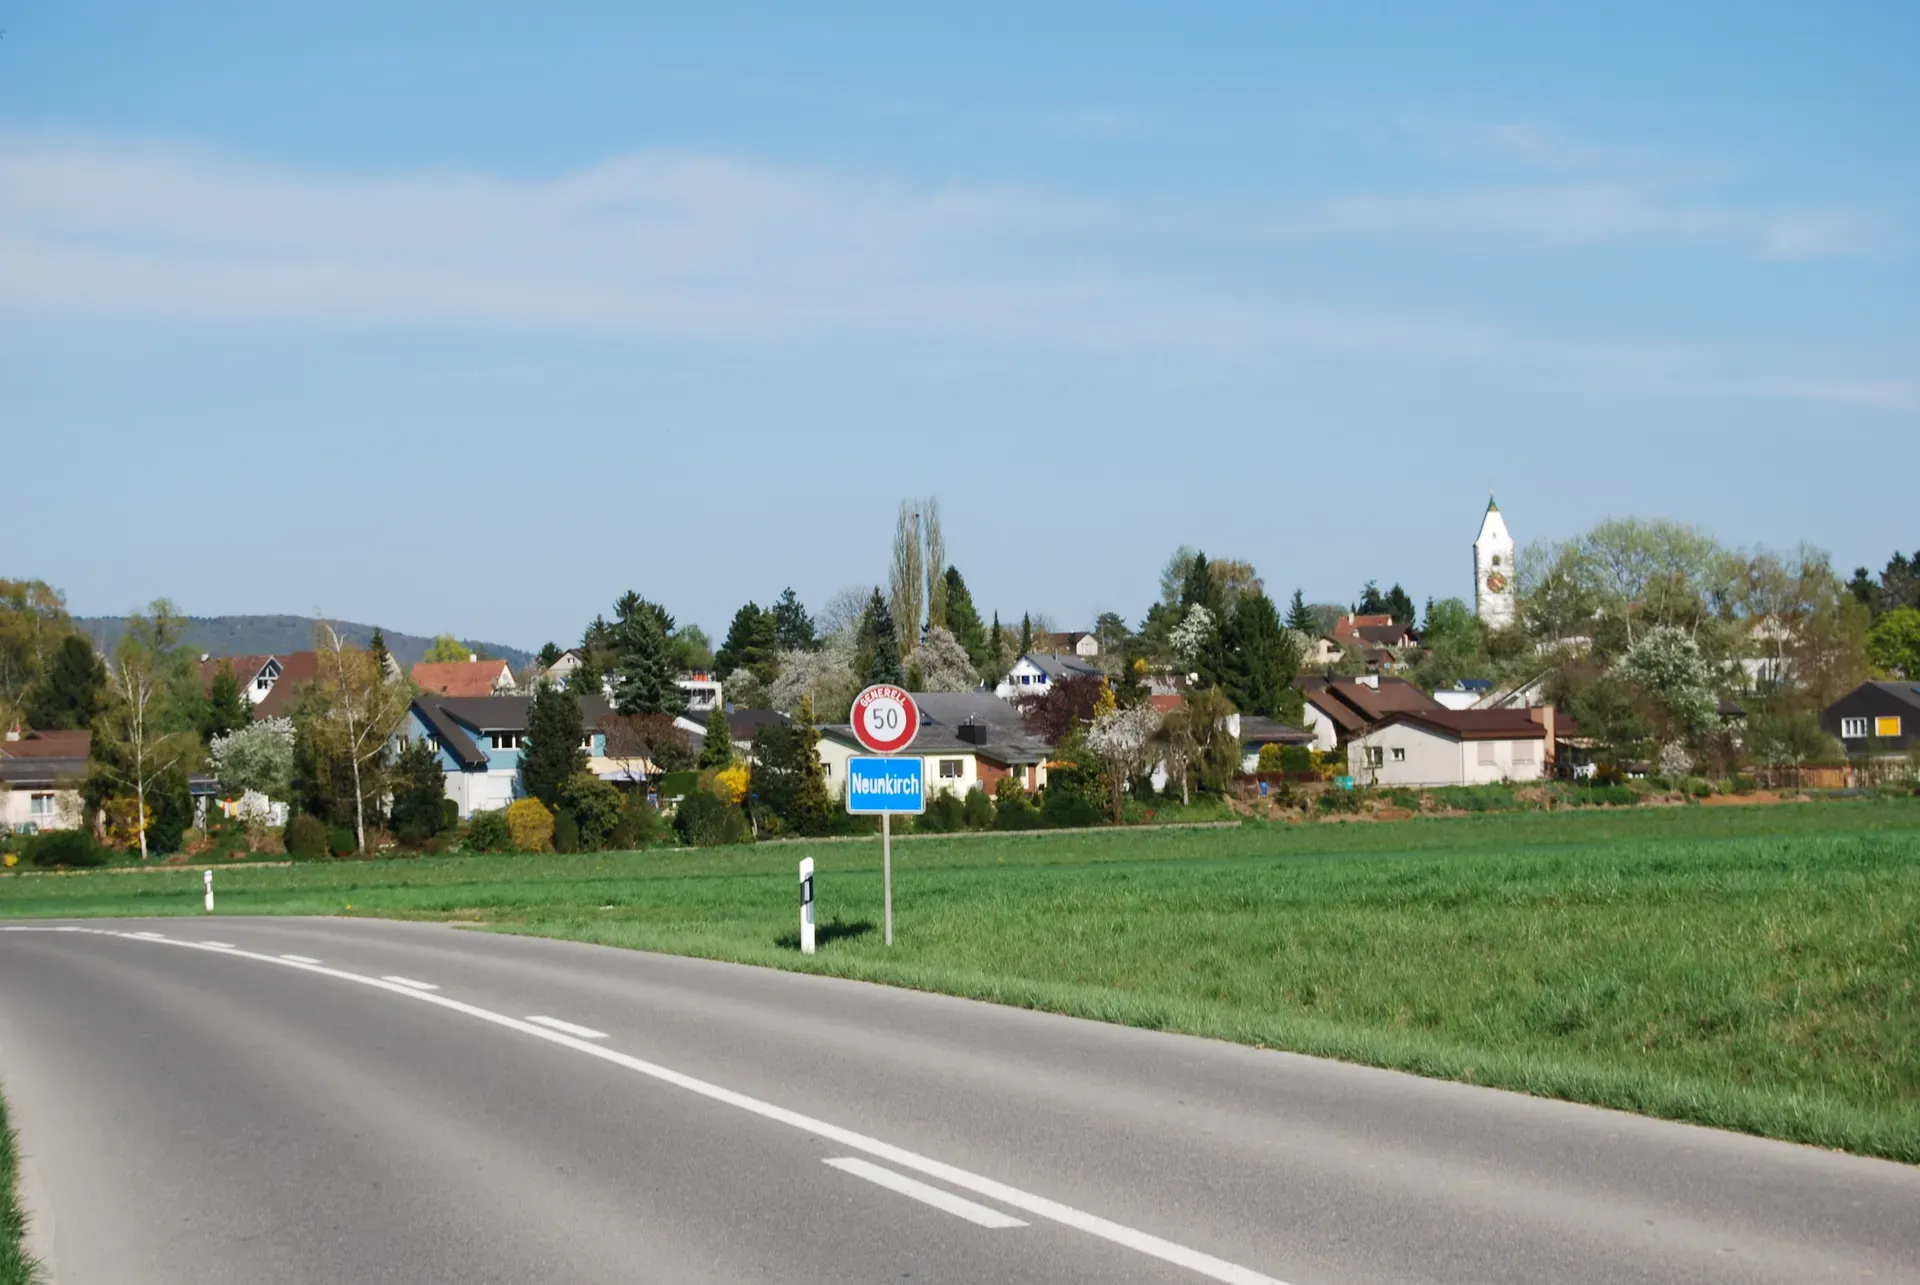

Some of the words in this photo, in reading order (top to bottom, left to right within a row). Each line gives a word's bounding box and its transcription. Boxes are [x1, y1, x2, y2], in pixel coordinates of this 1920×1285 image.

[860, 688, 906, 707] GENERELL
[873, 708, 898, 729] 50
[852, 772, 919, 795] Neunkirch
